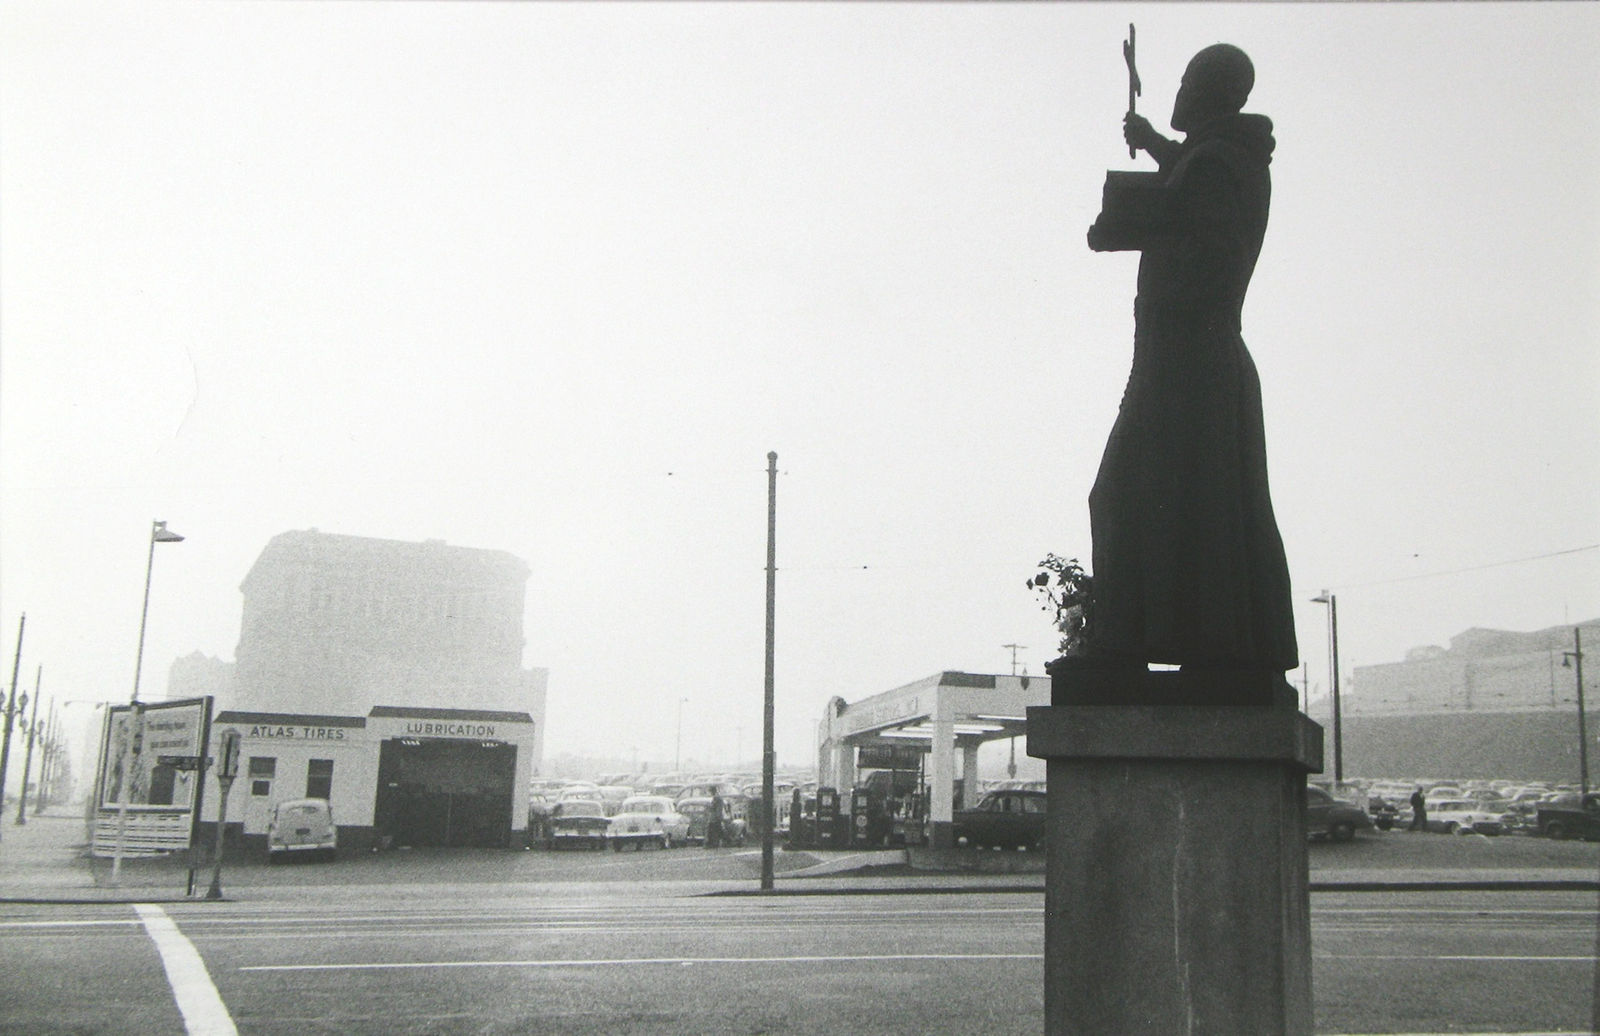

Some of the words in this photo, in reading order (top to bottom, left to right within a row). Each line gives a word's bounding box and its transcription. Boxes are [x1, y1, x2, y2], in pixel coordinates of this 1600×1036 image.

[250, 725, 295, 738] ATLAS
[303, 727, 344, 740] TIRES
[407, 722, 495, 736] LUBRICATION
